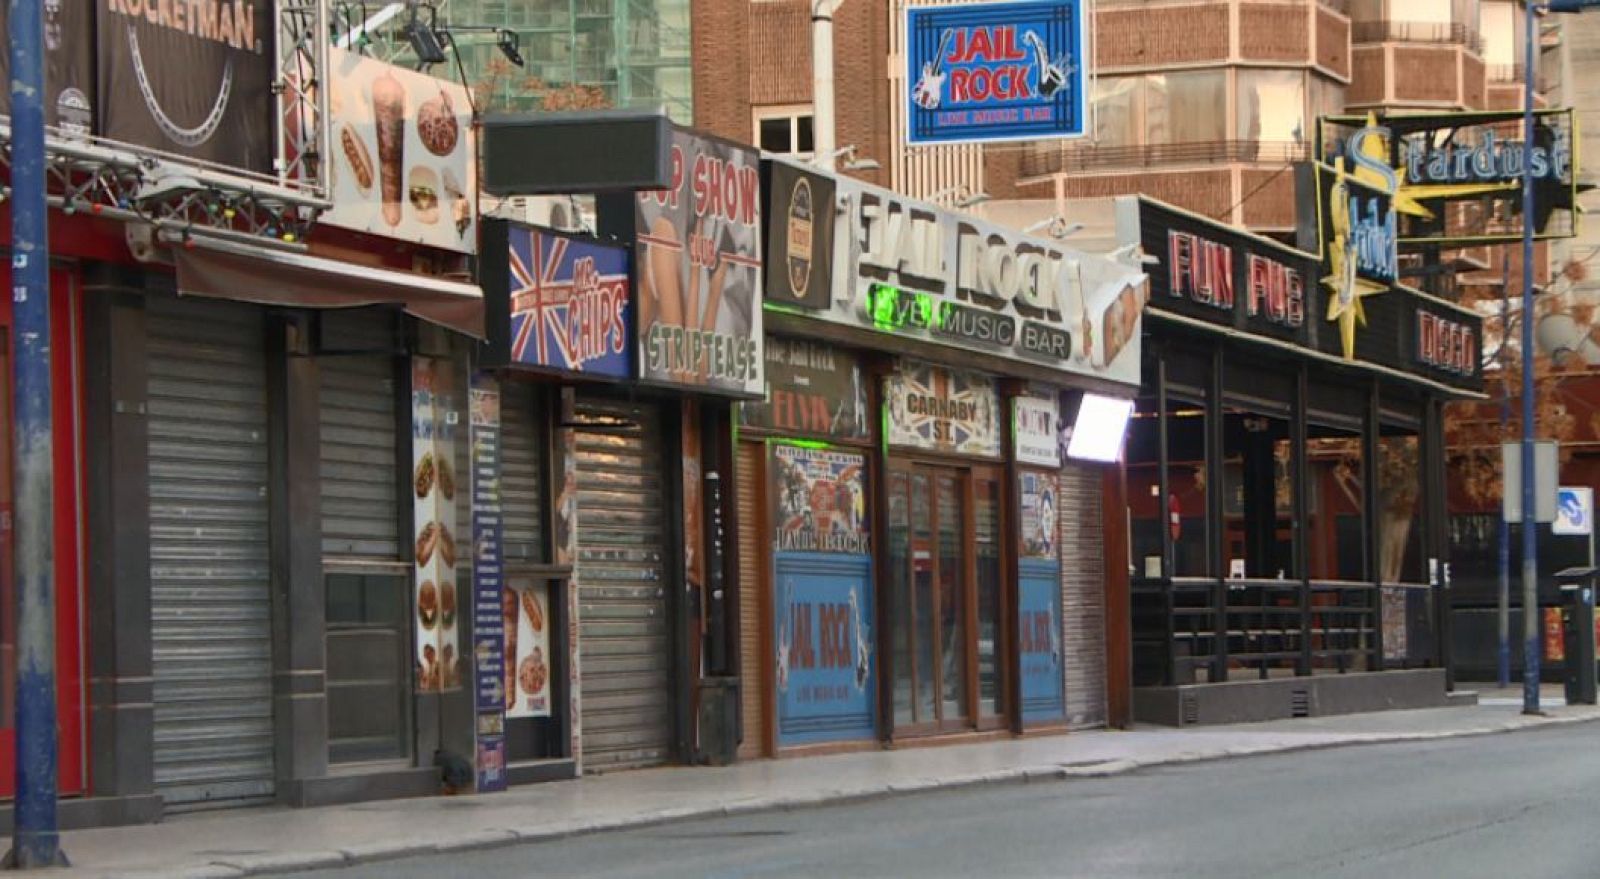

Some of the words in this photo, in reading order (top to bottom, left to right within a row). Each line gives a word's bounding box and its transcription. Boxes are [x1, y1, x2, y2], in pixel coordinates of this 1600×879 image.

[947, 24, 1027, 63] JAIL
[949, 64, 1032, 103] ROCK
[973, 108, 1018, 124] MUSIC
[1023, 106, 1052, 121] BAR
[1346, 126, 1567, 195] Stardust
[691, 152, 759, 227] SHOW
[1167, 229, 1234, 309] FUN
[1245, 252, 1305, 327] PUB
[566, 283, 625, 368] CHIPS
[648, 320, 757, 381] STRIPTEASE
[943, 303, 1012, 344] MUSIC
[1024, 325, 1066, 357] BAR
[907, 392, 977, 422] CARNABY
[934, 419, 954, 442] ST.
